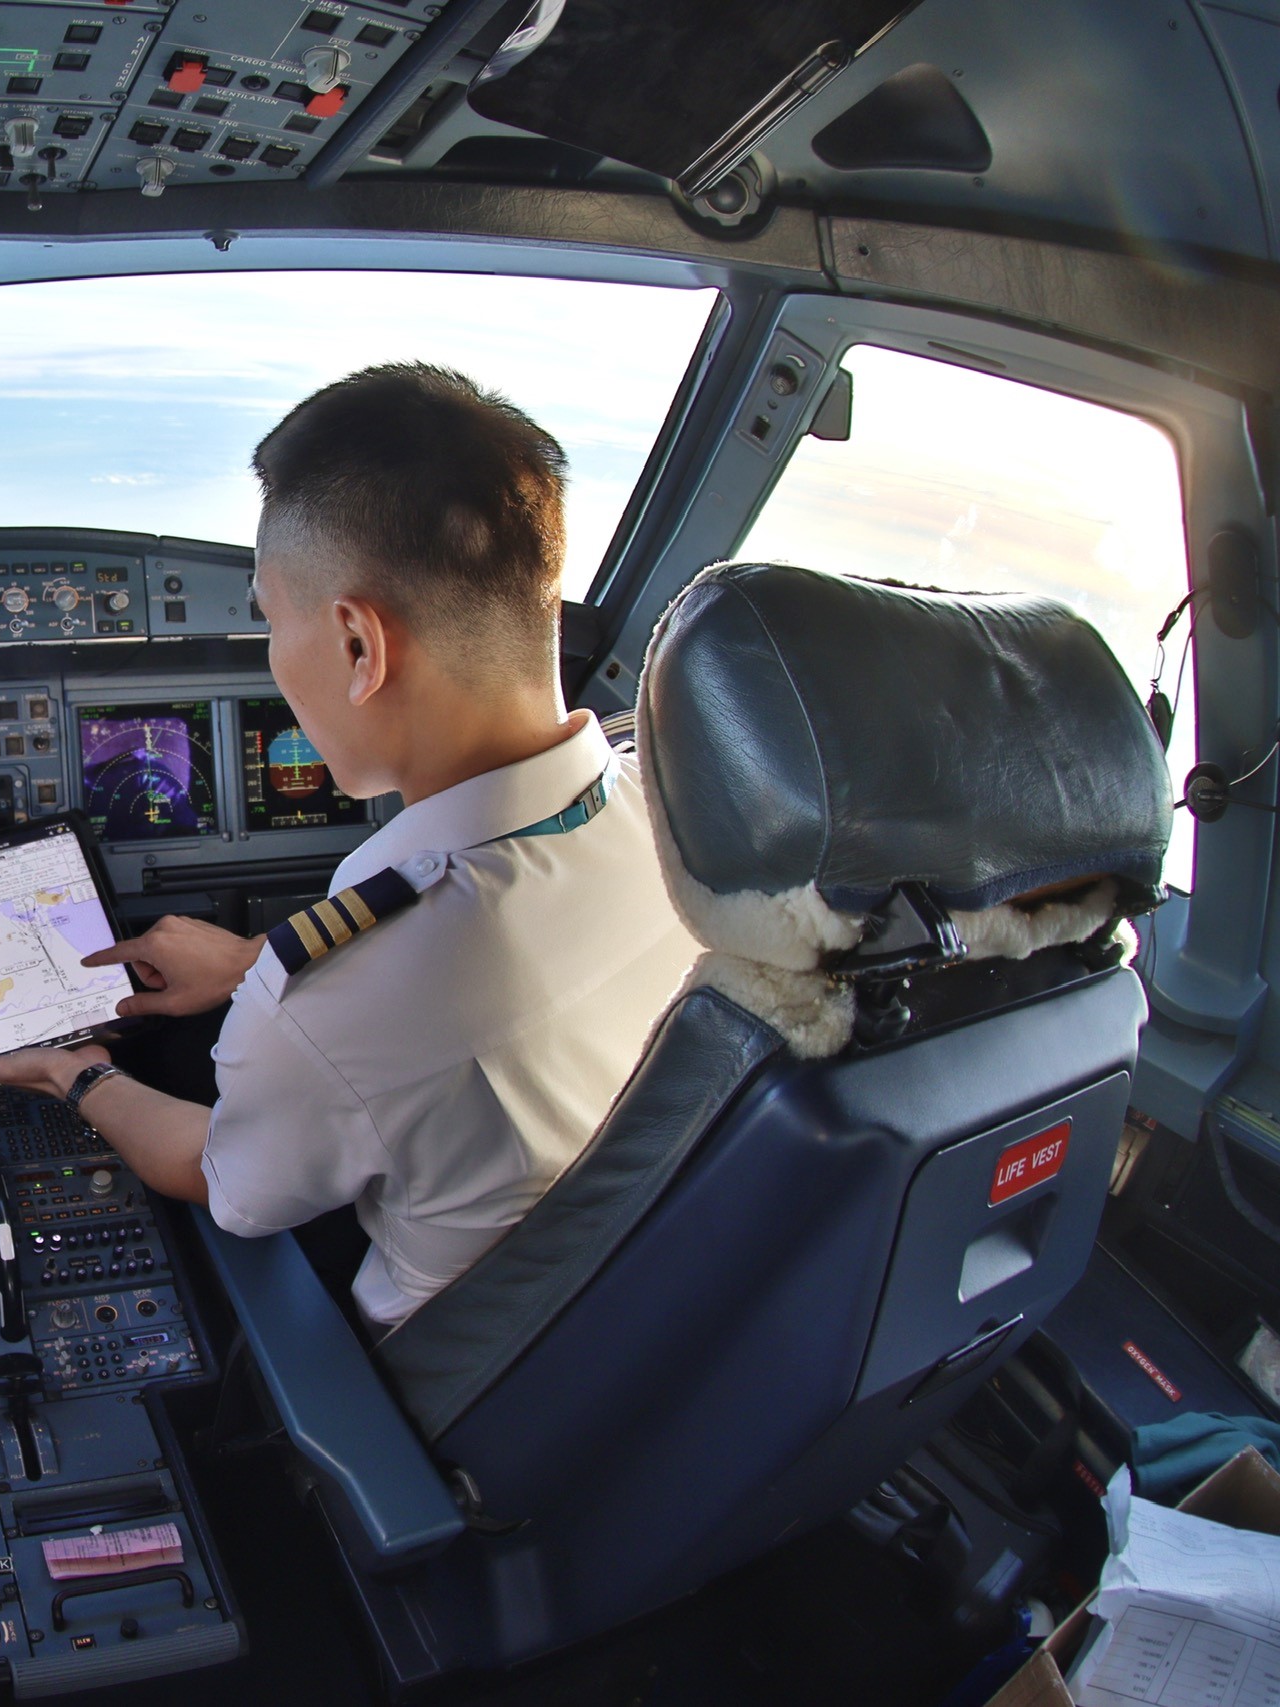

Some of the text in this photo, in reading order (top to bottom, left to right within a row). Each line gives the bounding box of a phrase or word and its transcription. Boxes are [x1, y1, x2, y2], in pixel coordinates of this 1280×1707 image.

[229, 55, 306, 75] CARGO SMOKE
[215, 88, 280, 106] VENTILATION
[218, 119, 240, 127] ENG
[202, 152, 227, 161] RAIN
[997, 1140, 1062, 1187] LIFE VEST
[1127, 1346, 1176, 1397] OXYGEN MASK
